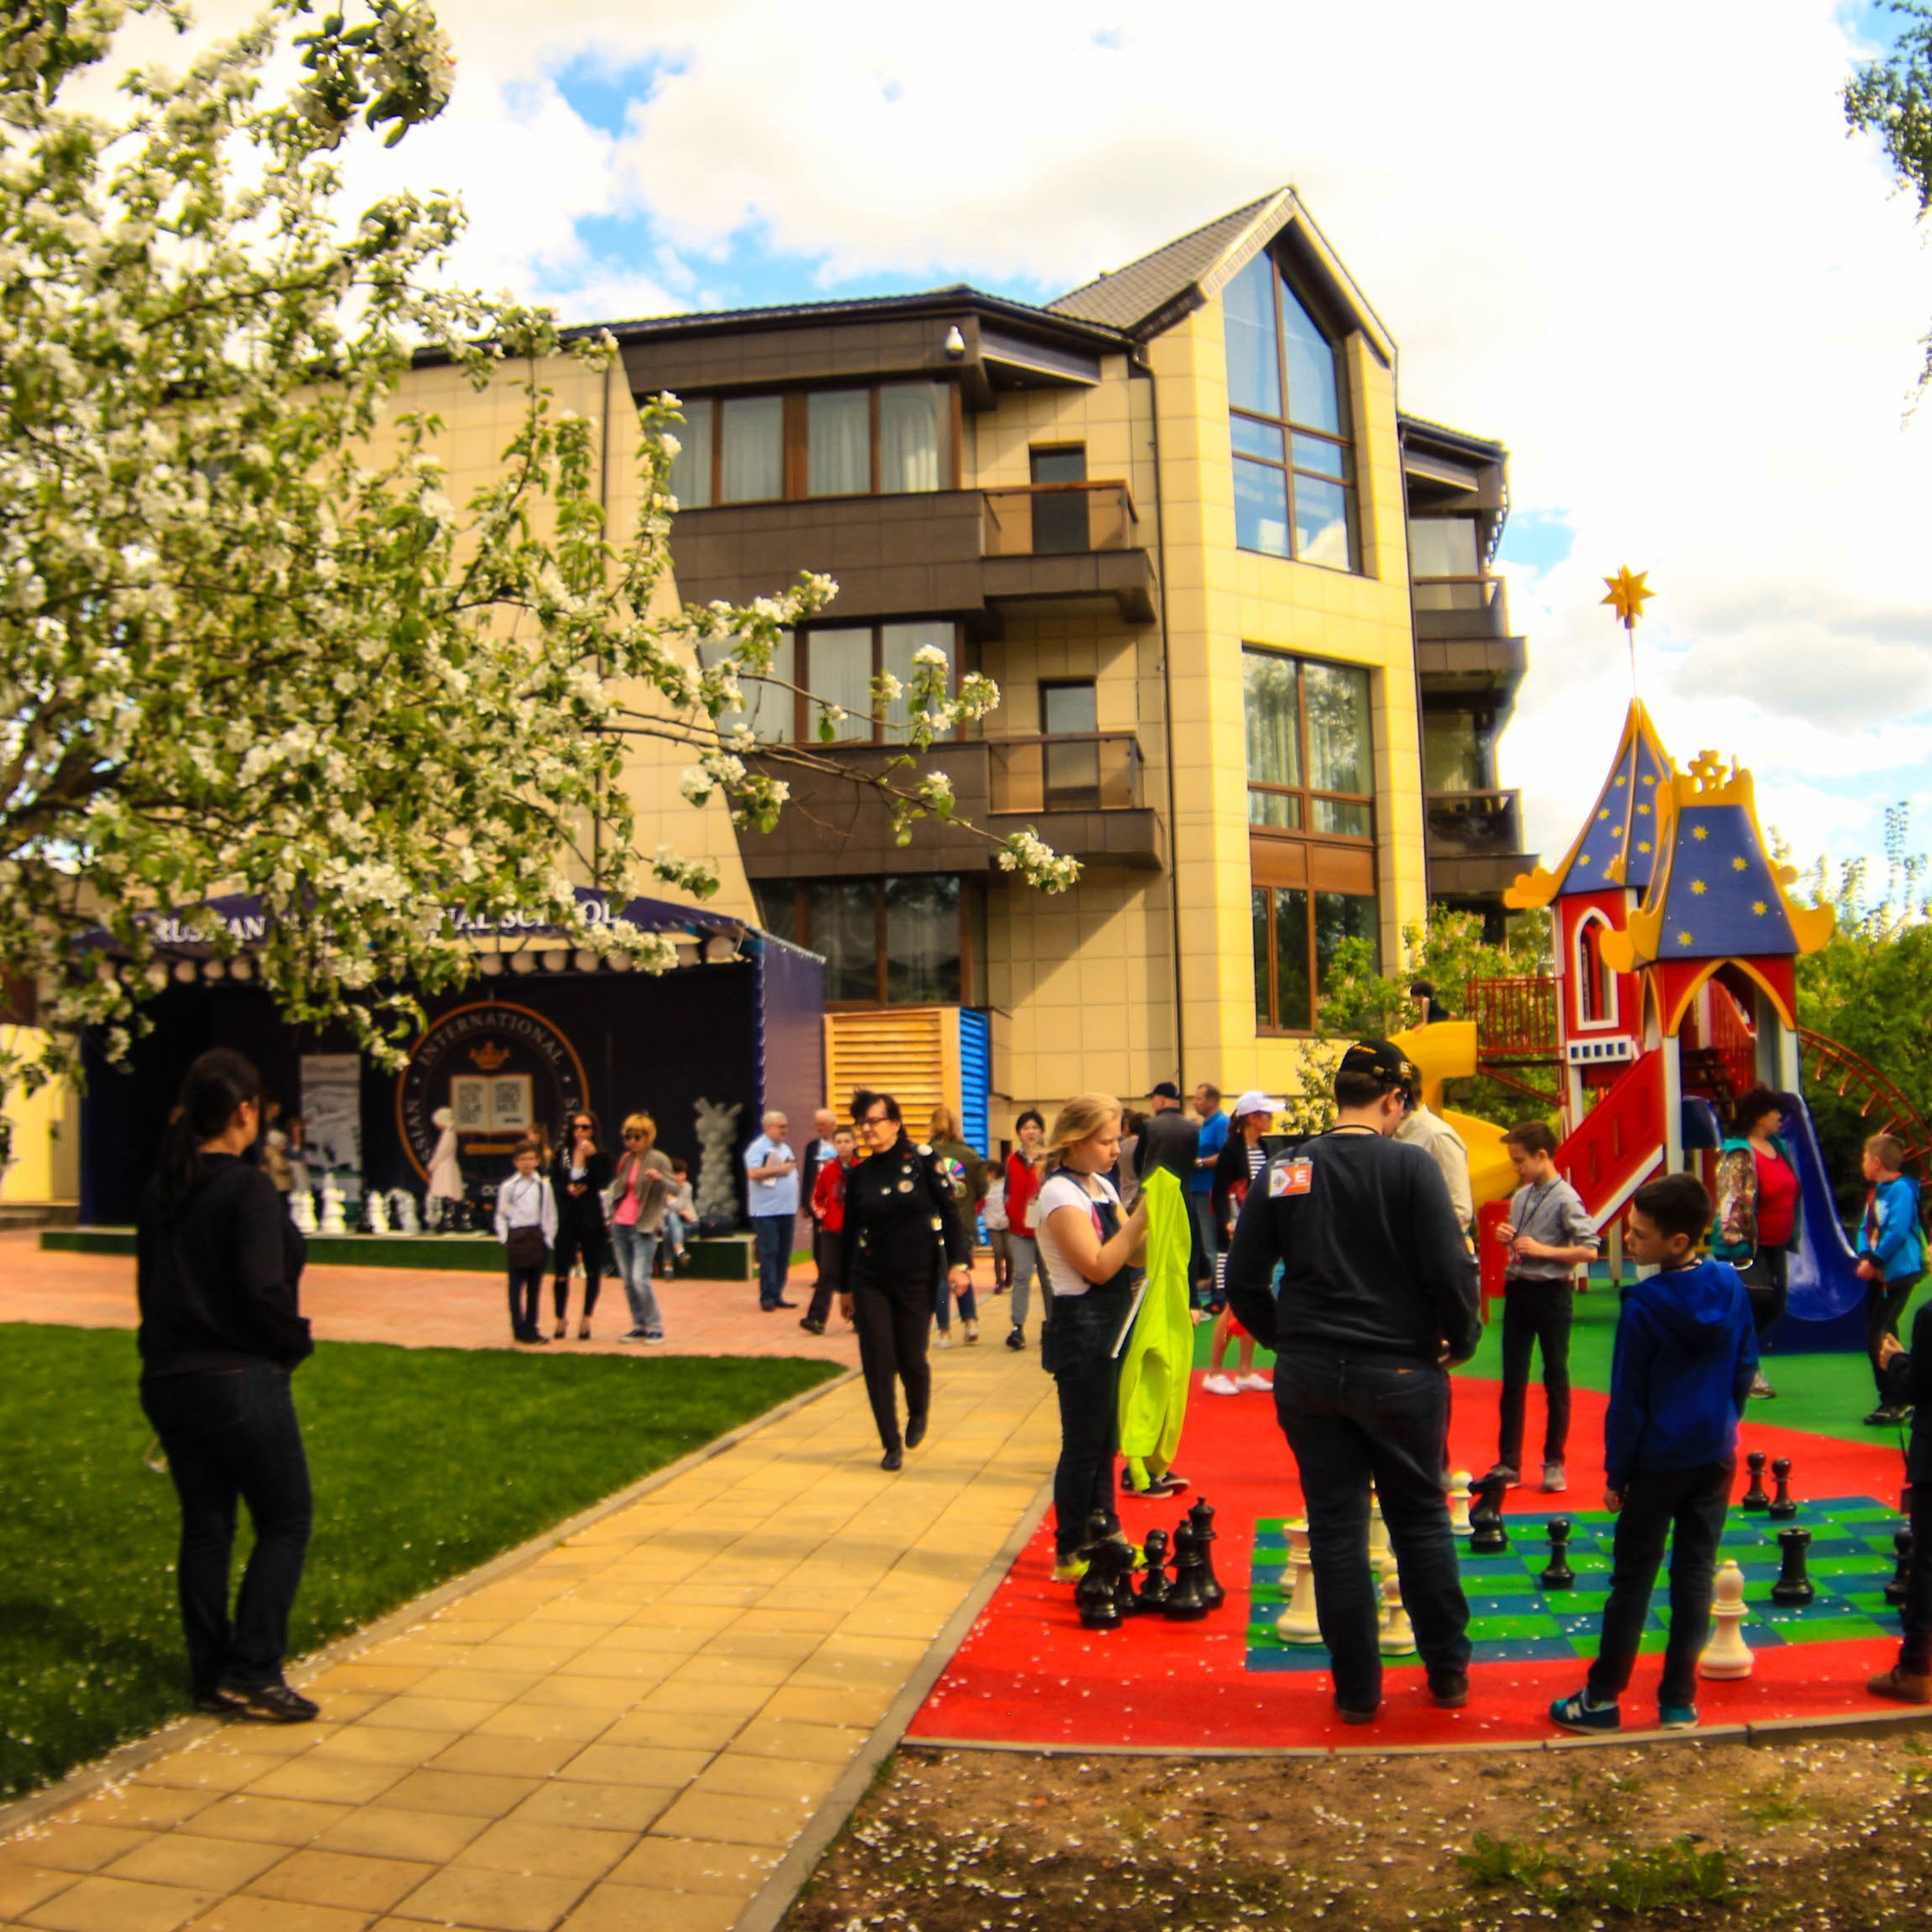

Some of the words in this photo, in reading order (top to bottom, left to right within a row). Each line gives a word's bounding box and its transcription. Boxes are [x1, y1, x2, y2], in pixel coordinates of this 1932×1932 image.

[499, 899, 620, 928] SCOL
[417, 1012, 565, 1066] INTERNATIONAL
[1295, 1170, 1307, 1183] E
[1566, 1702, 1583, 1720] N
